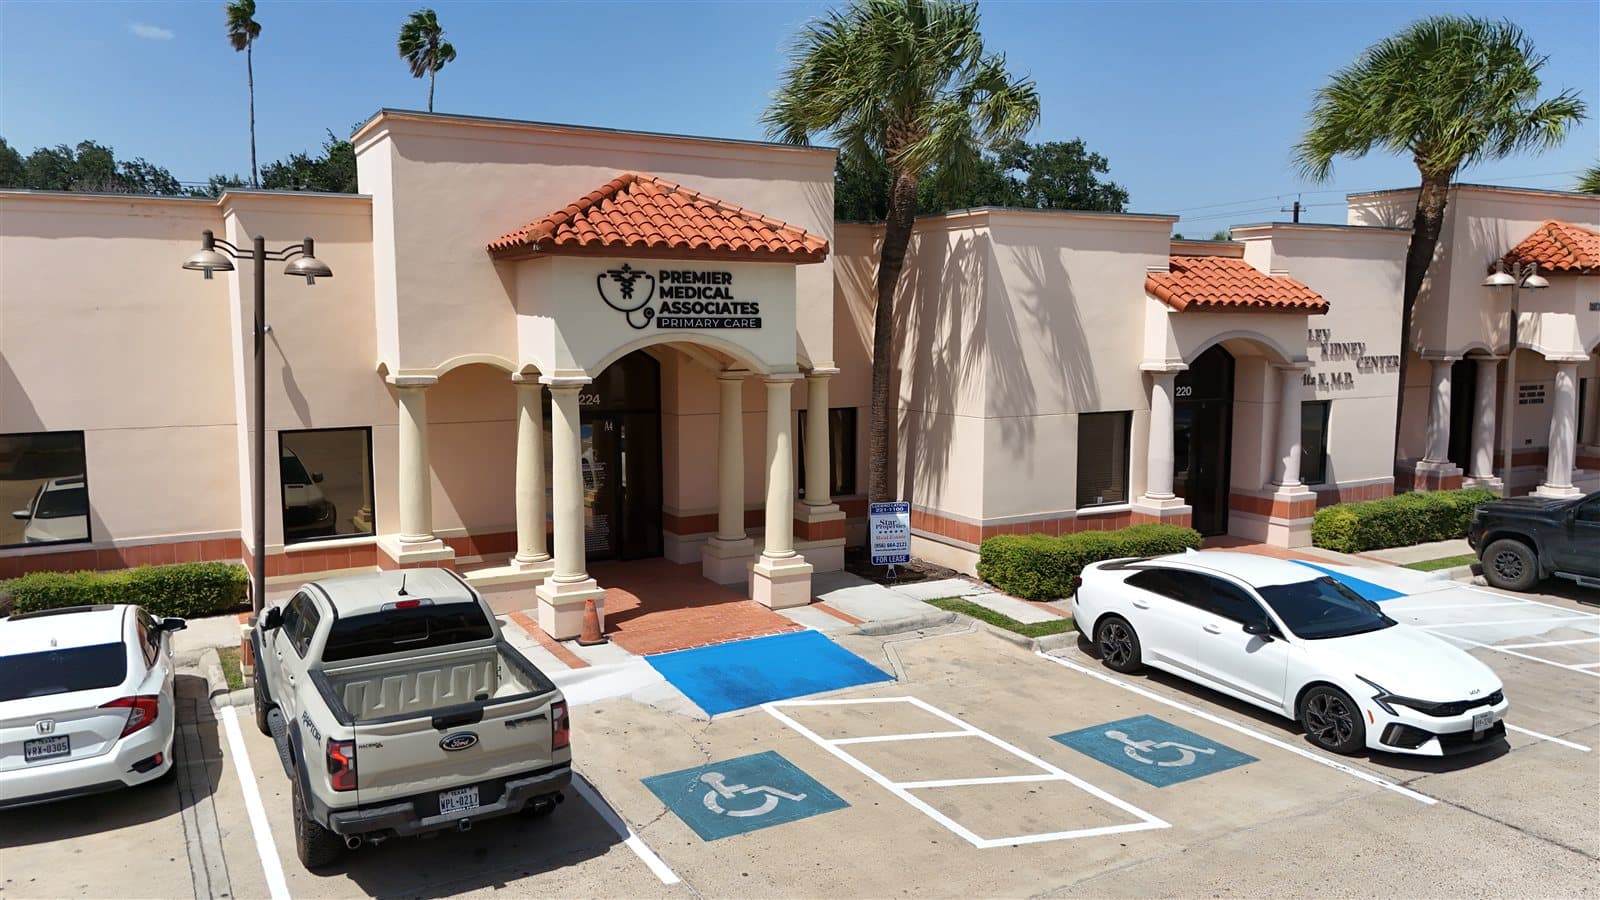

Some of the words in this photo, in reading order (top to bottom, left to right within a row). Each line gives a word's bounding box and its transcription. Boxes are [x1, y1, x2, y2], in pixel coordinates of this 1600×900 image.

[658, 270, 732, 285] PREMIER
[659, 286, 734, 300] MEDICAL
[659, 301, 760, 315] ASSOCIATES
[662, 318, 720, 328] PRIMARY
[723, 318, 757, 328] CARE
[1320, 342, 1366, 357] KIDNEY
[1356, 355, 1400, 369] CENTER
[1175, 386, 1192, 397] 220
[578, 394, 601, 405] 224
[301, 710, 322, 747] RAPTOR
